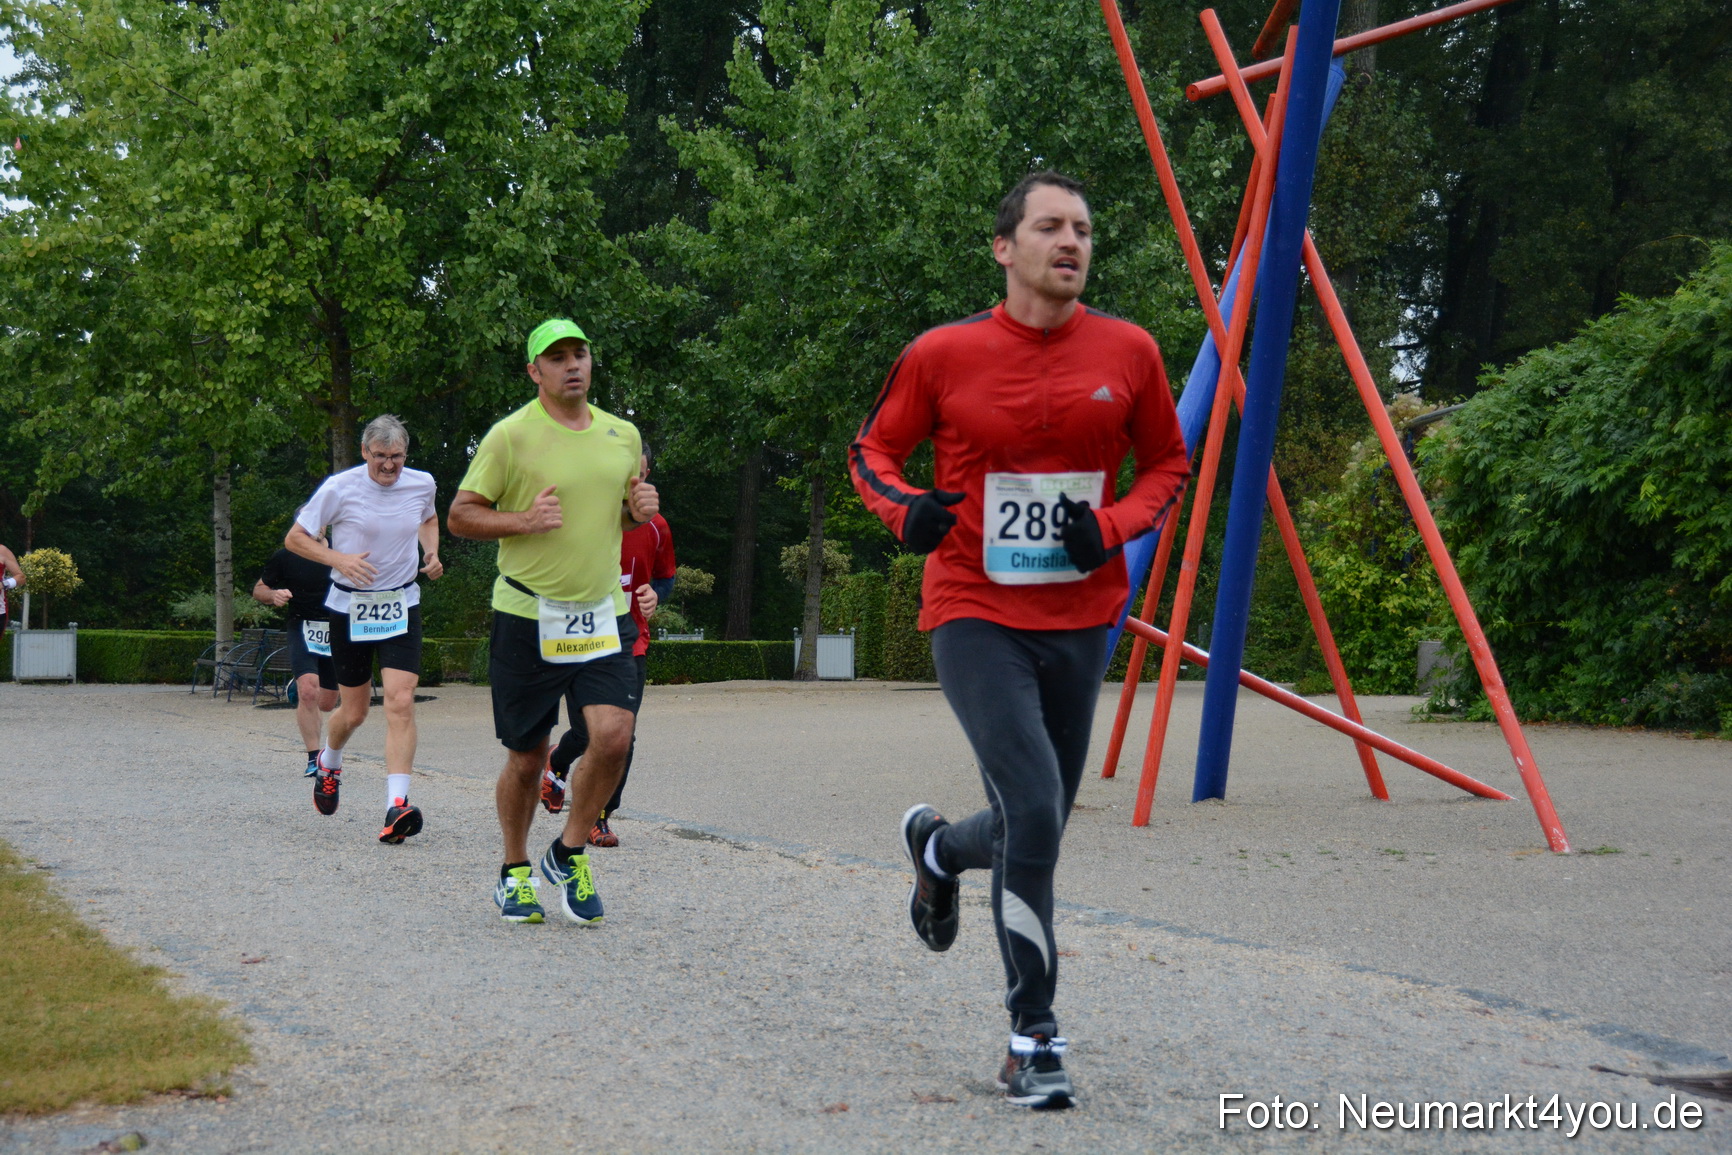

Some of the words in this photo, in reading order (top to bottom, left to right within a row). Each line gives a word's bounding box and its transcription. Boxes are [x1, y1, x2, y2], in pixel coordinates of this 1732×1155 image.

[999, 501, 1090, 541] 289
[356, 602, 403, 621] 2423
[363, 624, 397, 634] Bernhard
[565, 611, 596, 634] 29
[556, 640, 606, 653] Alexander
